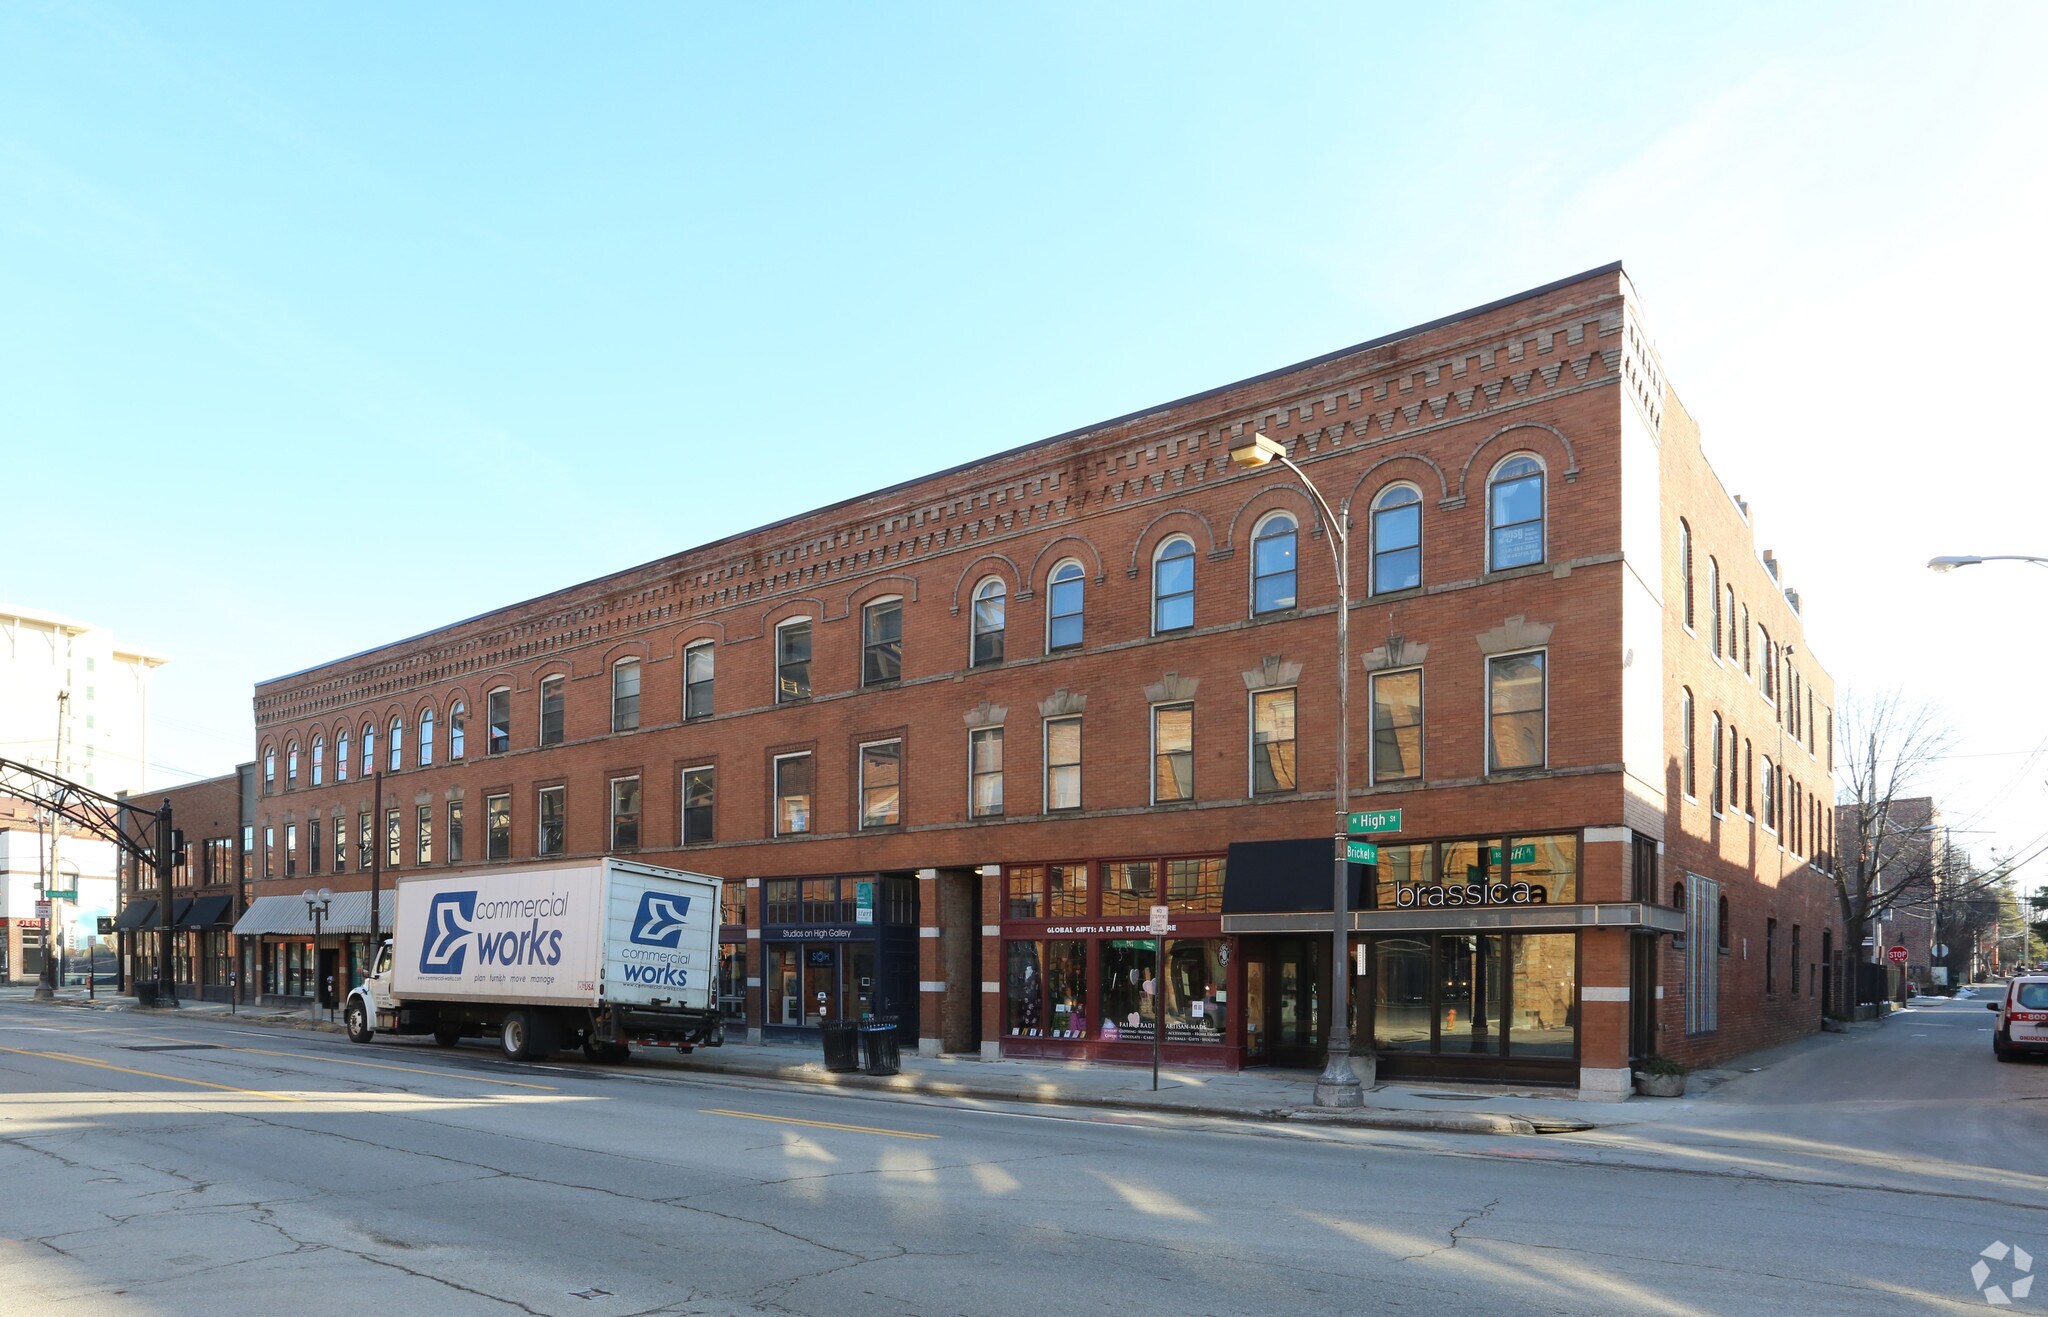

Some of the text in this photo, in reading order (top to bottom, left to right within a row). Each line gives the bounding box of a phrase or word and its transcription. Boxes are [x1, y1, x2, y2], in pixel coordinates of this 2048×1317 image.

[1360, 814, 1386, 829] High
[1389, 815, 1396, 823] St
[1347, 845, 1370, 860] Brickel
[1395, 877, 1531, 908] brassica
[476, 891, 570, 920] commercial
[477, 918, 563, 966] works
[783, 929, 804, 938] Studios
[814, 929, 827, 939] High
[828, 929, 851, 938] Gallery
[621, 948, 691, 965] commercial
[474, 974, 486, 982] plan
[530, 976, 555, 985] manage
[624, 962, 688, 987] works
